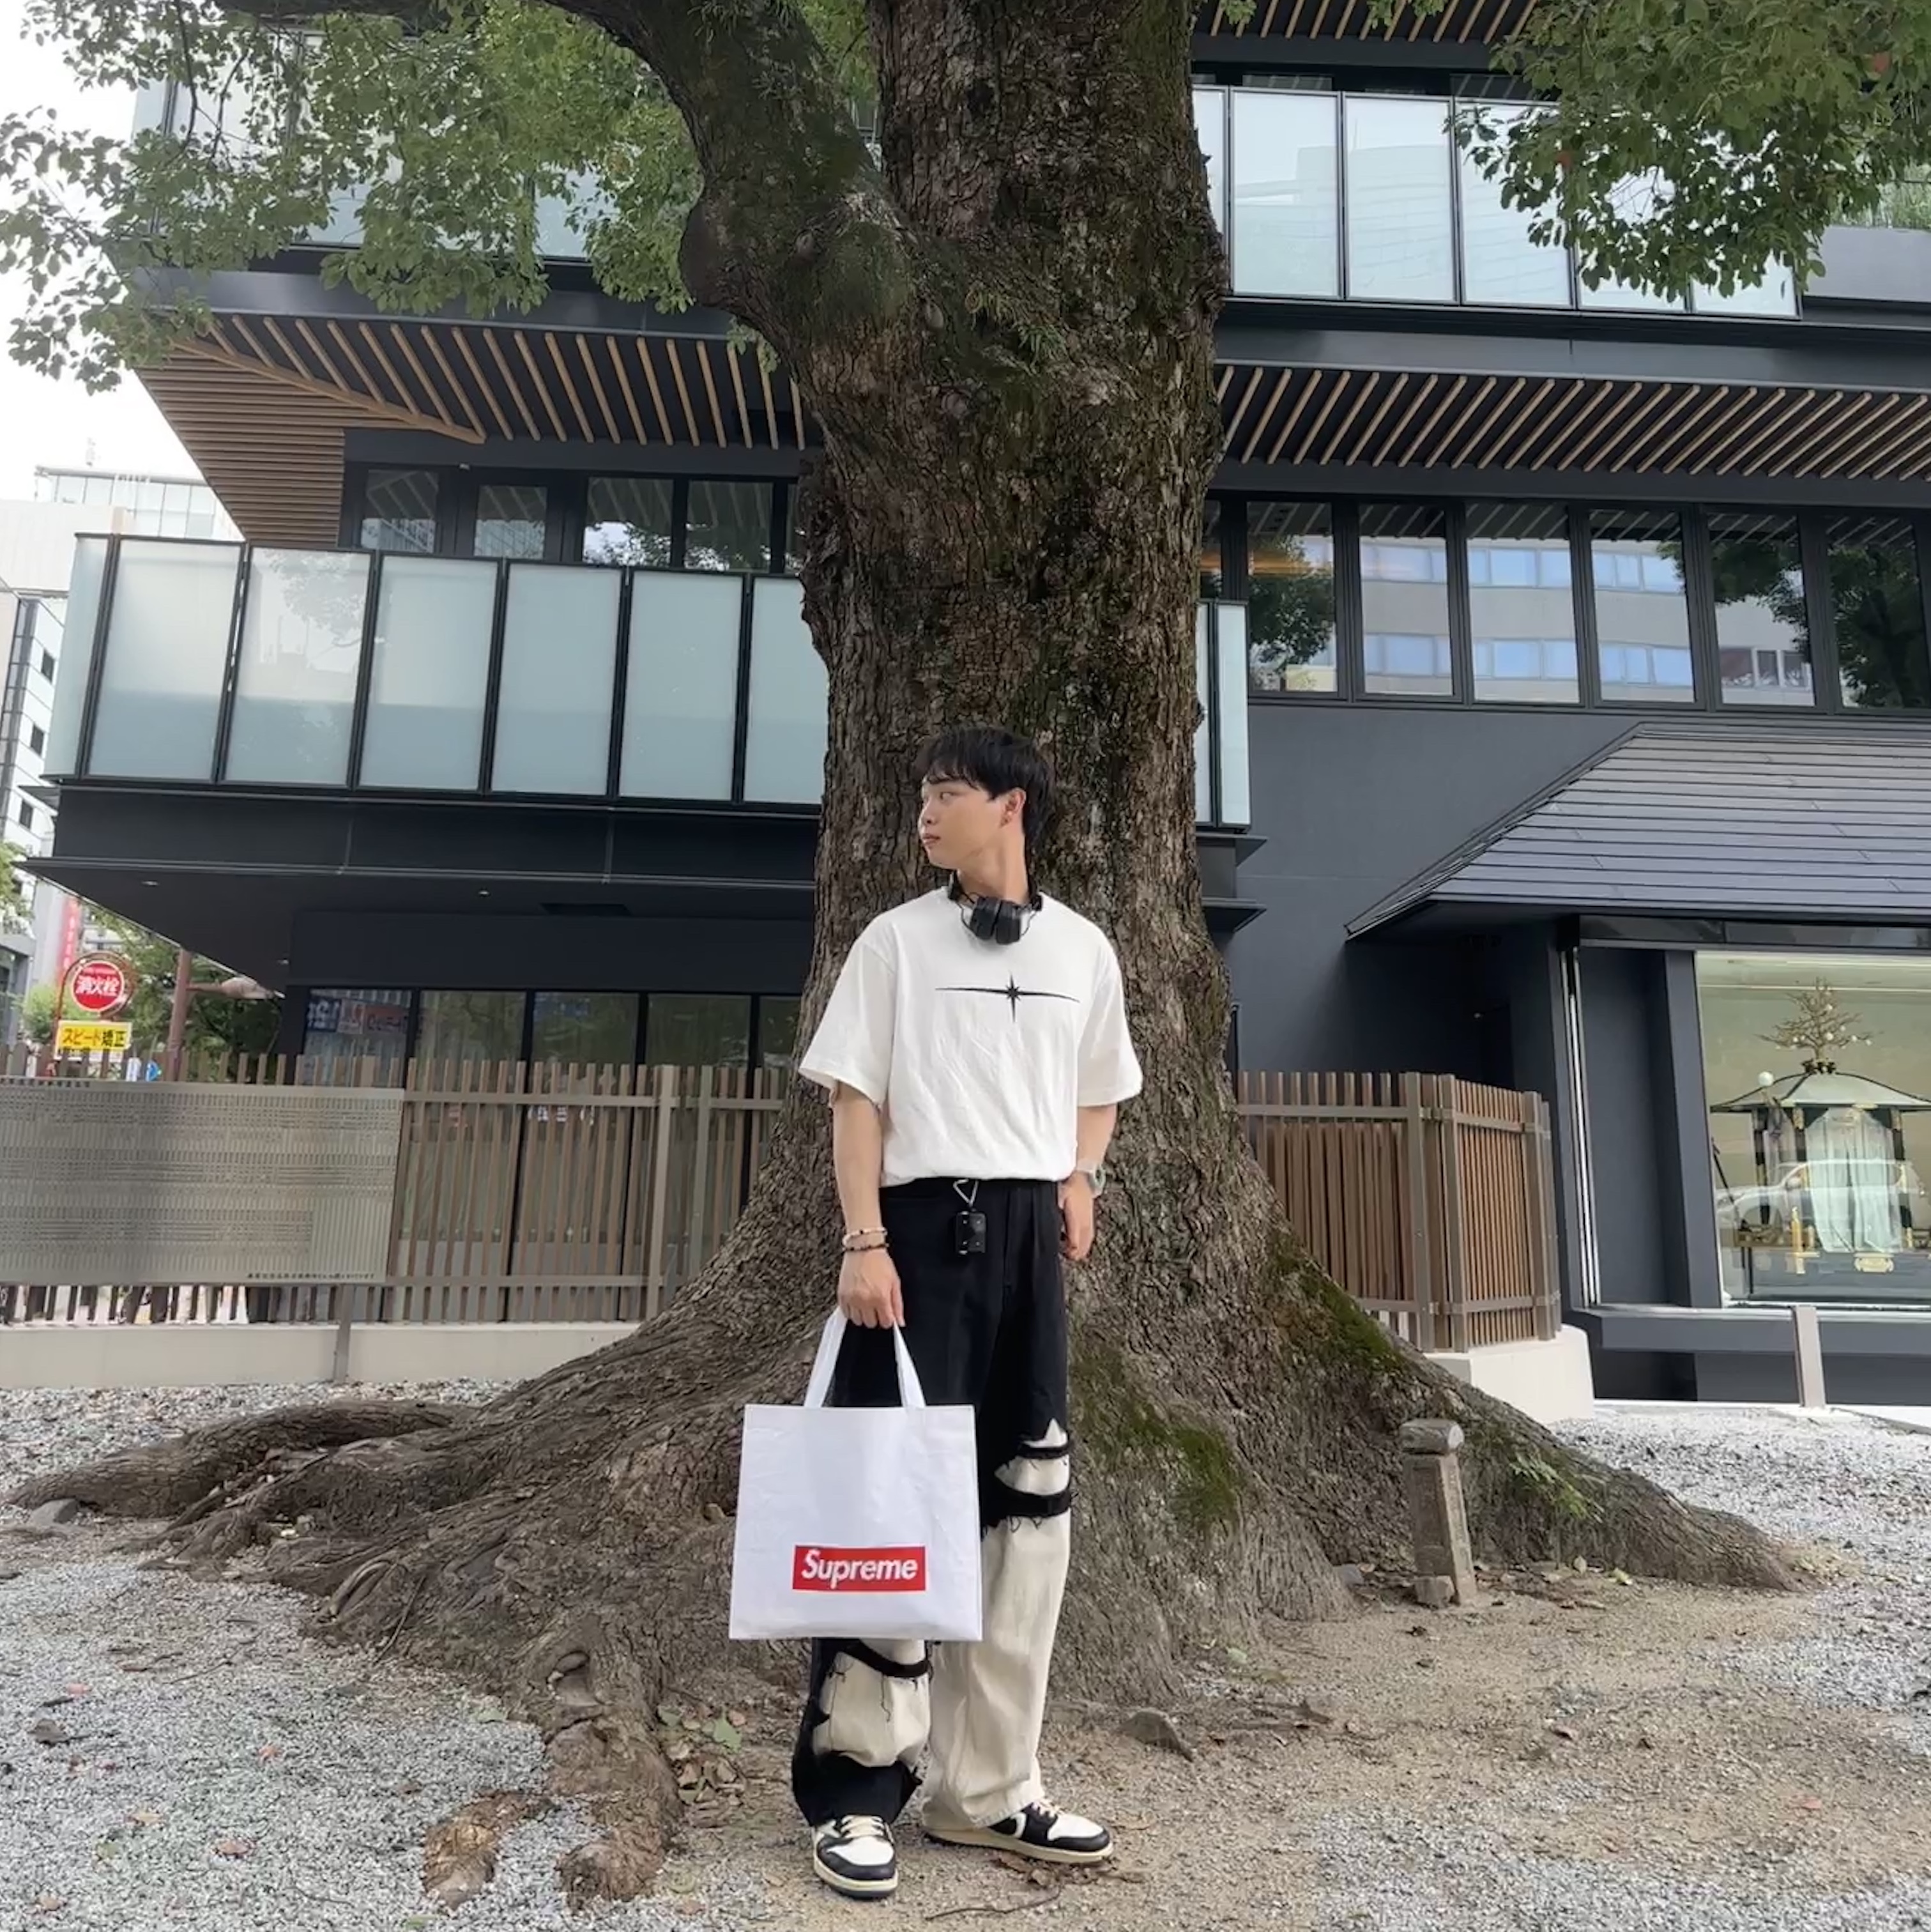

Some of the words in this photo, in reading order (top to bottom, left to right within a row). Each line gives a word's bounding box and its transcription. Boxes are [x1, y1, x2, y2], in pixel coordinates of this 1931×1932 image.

[75, 975, 119, 997] 消火栓
[801, 1548, 919, 1590] Supreme
